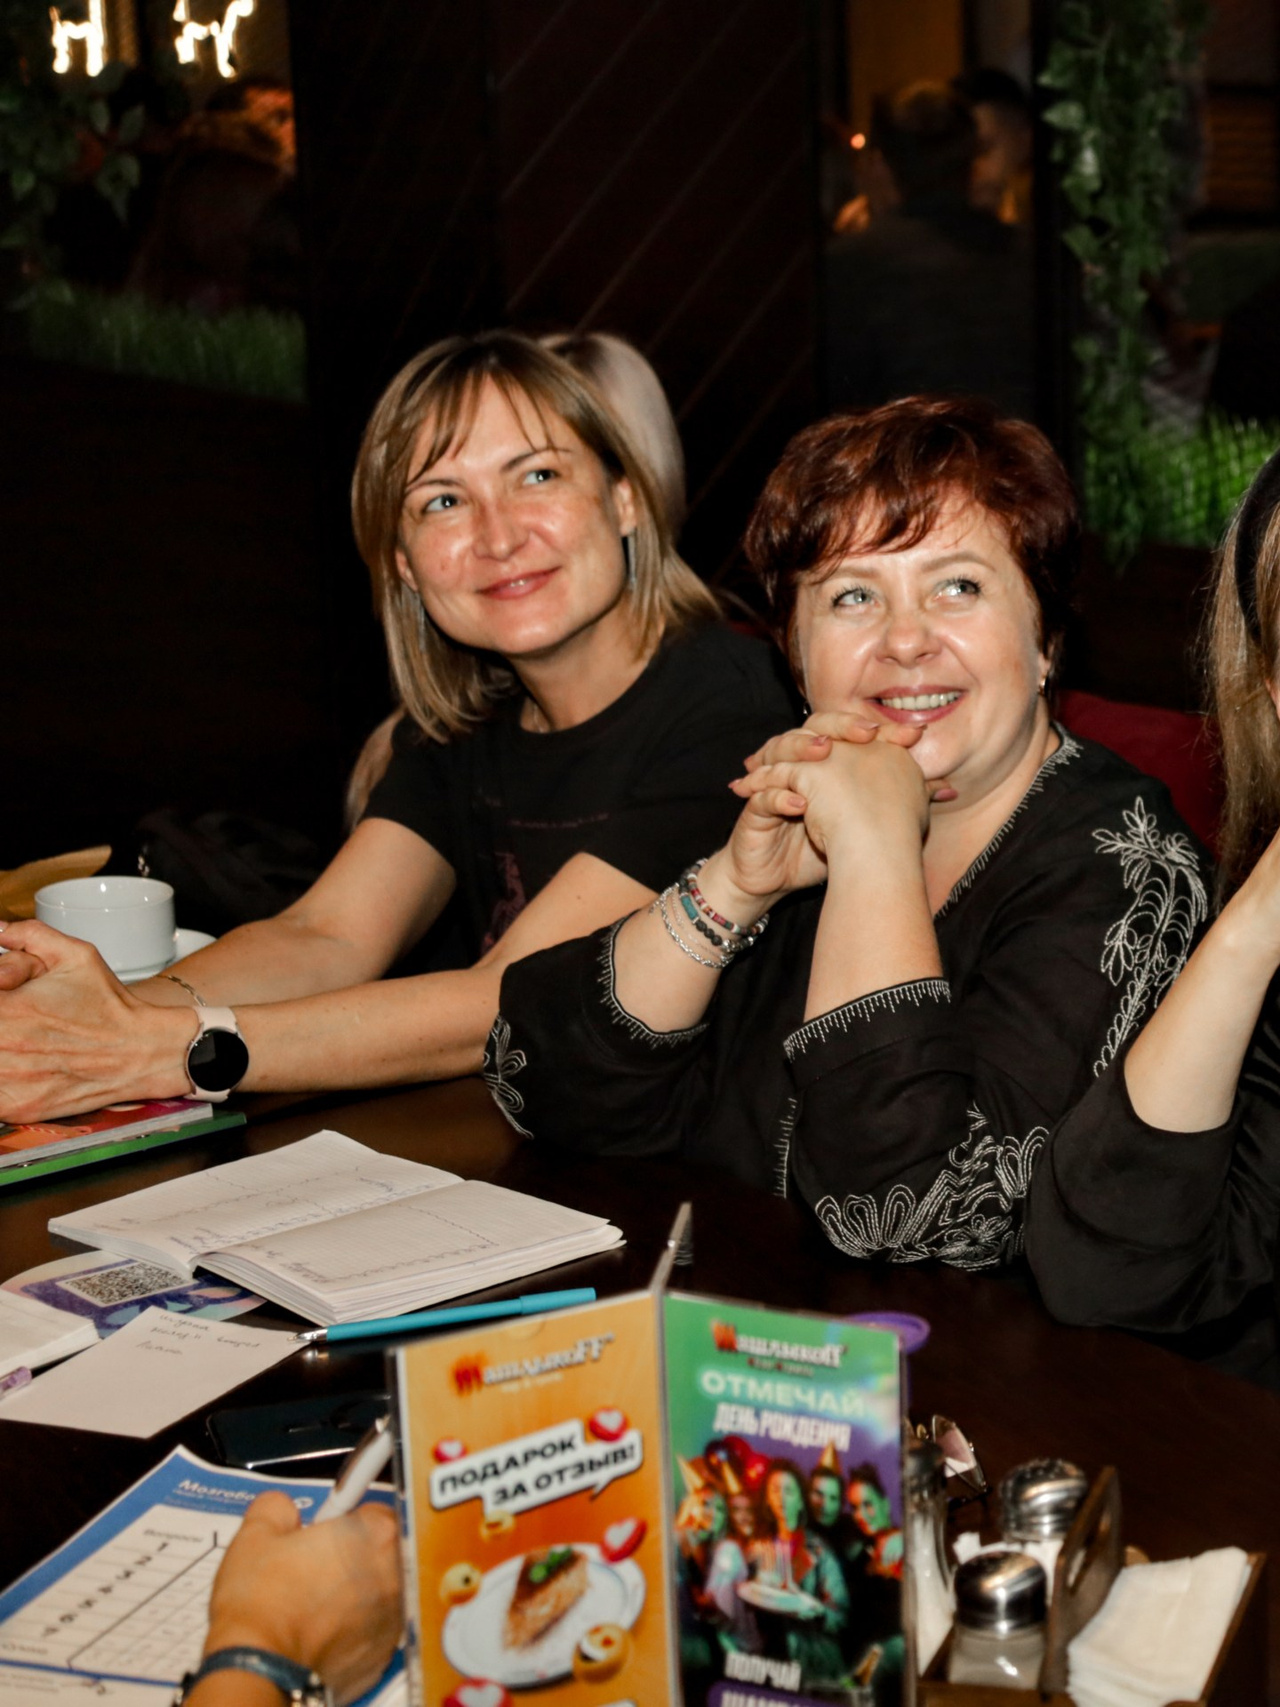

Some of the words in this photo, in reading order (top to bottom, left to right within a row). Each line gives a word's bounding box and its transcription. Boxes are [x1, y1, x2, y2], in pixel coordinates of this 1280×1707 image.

[701, 1369, 868, 1418] ОТМЕЧАЙ
[713, 1402, 757, 1437] ДЕНЬ
[759, 1409, 851, 1452] РОЖДЕНИЯ
[439, 1434, 577, 1495] ПОДАРОК
[493, 1485, 527, 1504] ЗА
[535, 1445, 635, 1489] ОТЗЫВ!
[178, 1478, 257, 1501] Мозгобо
[725, 1652, 801, 1690] ПОЛУЧАЙ
